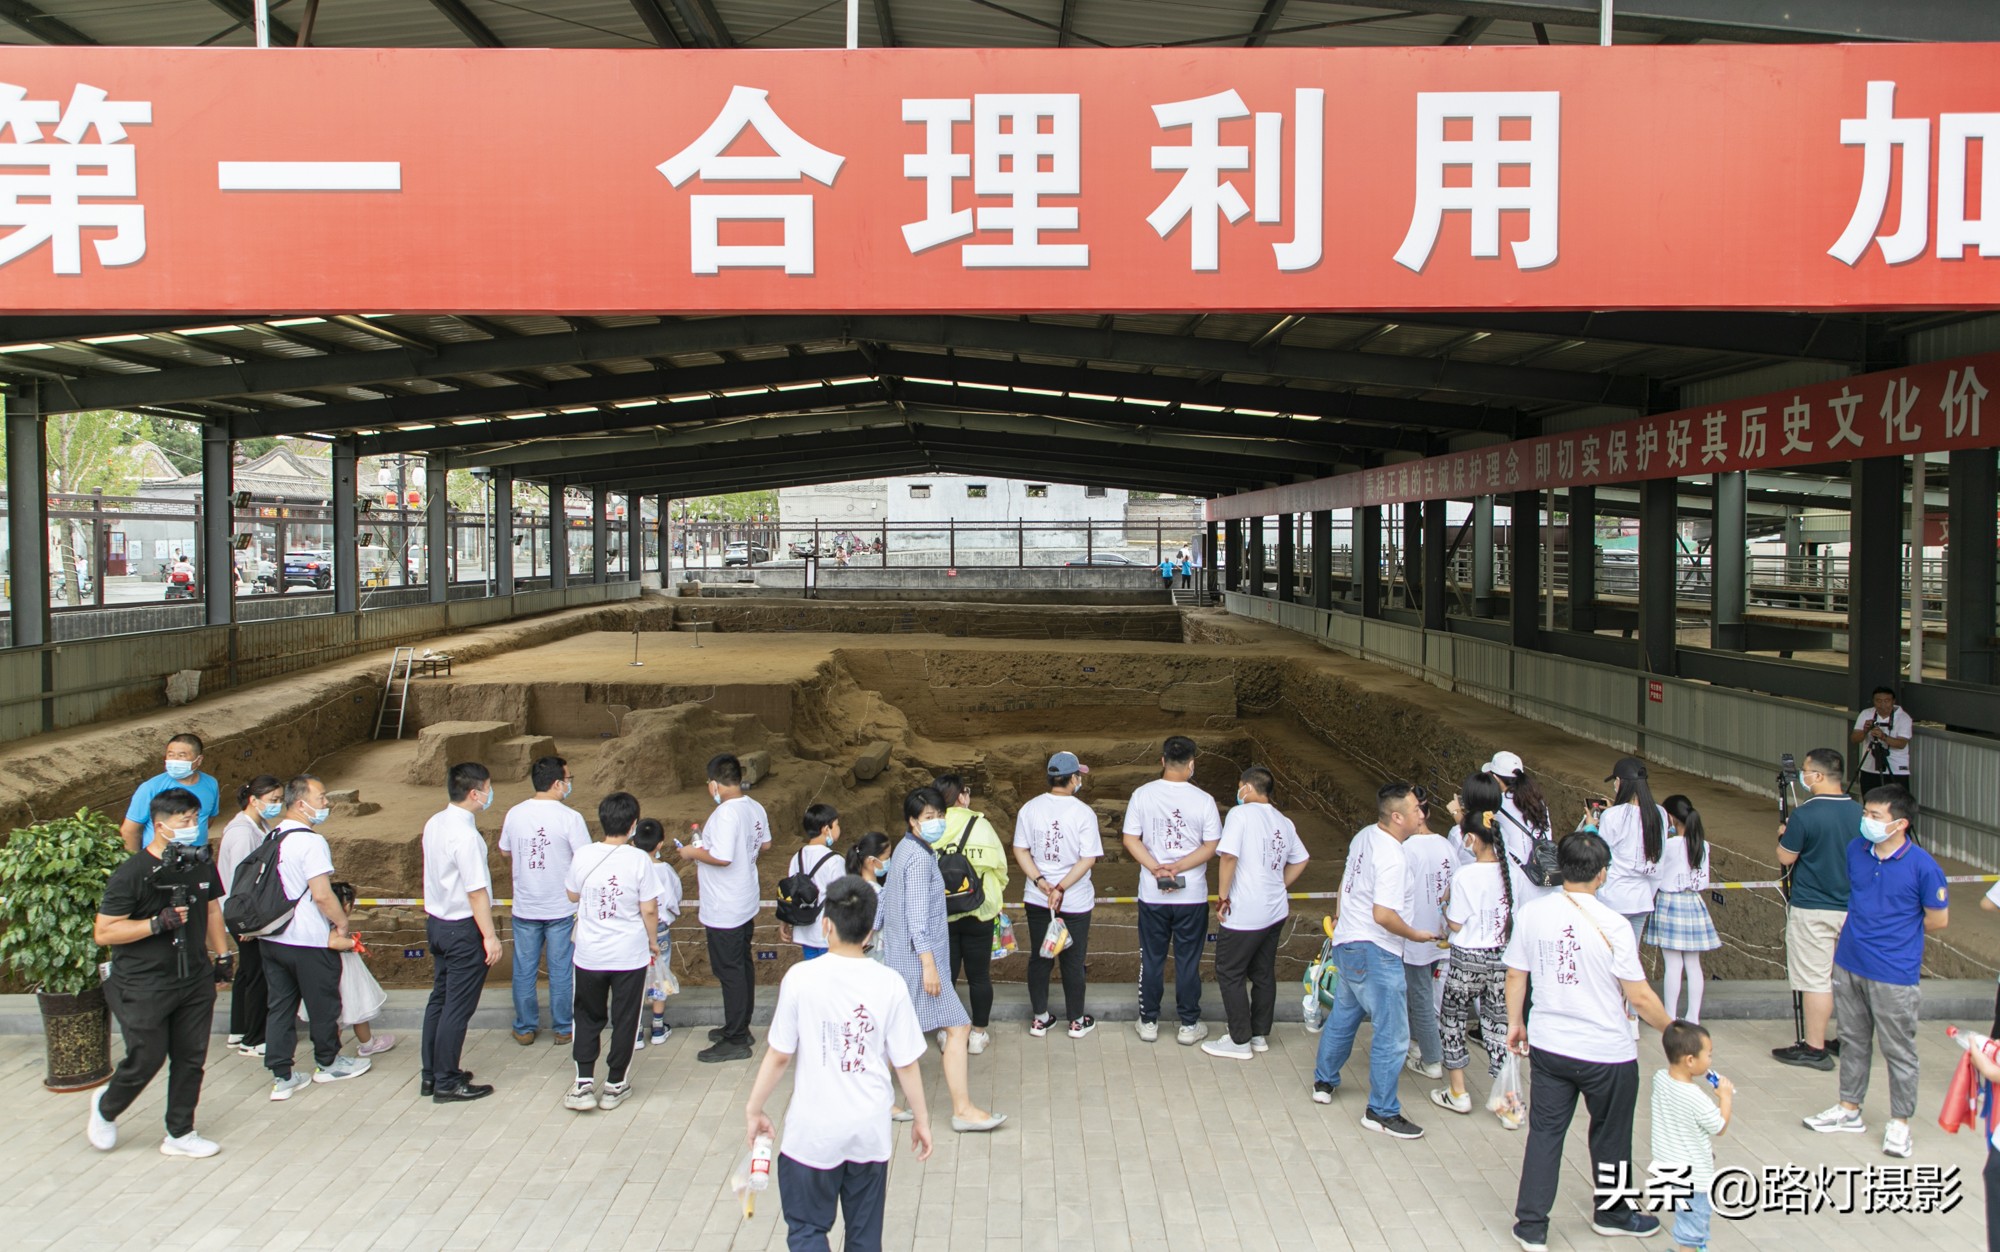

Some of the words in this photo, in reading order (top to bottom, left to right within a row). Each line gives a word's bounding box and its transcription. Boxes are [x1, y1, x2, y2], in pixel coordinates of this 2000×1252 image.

[0, 82, 402, 275] 第一
[655, 84, 1562, 275] 合理利用
[1826, 80, 2000, 267] 加
